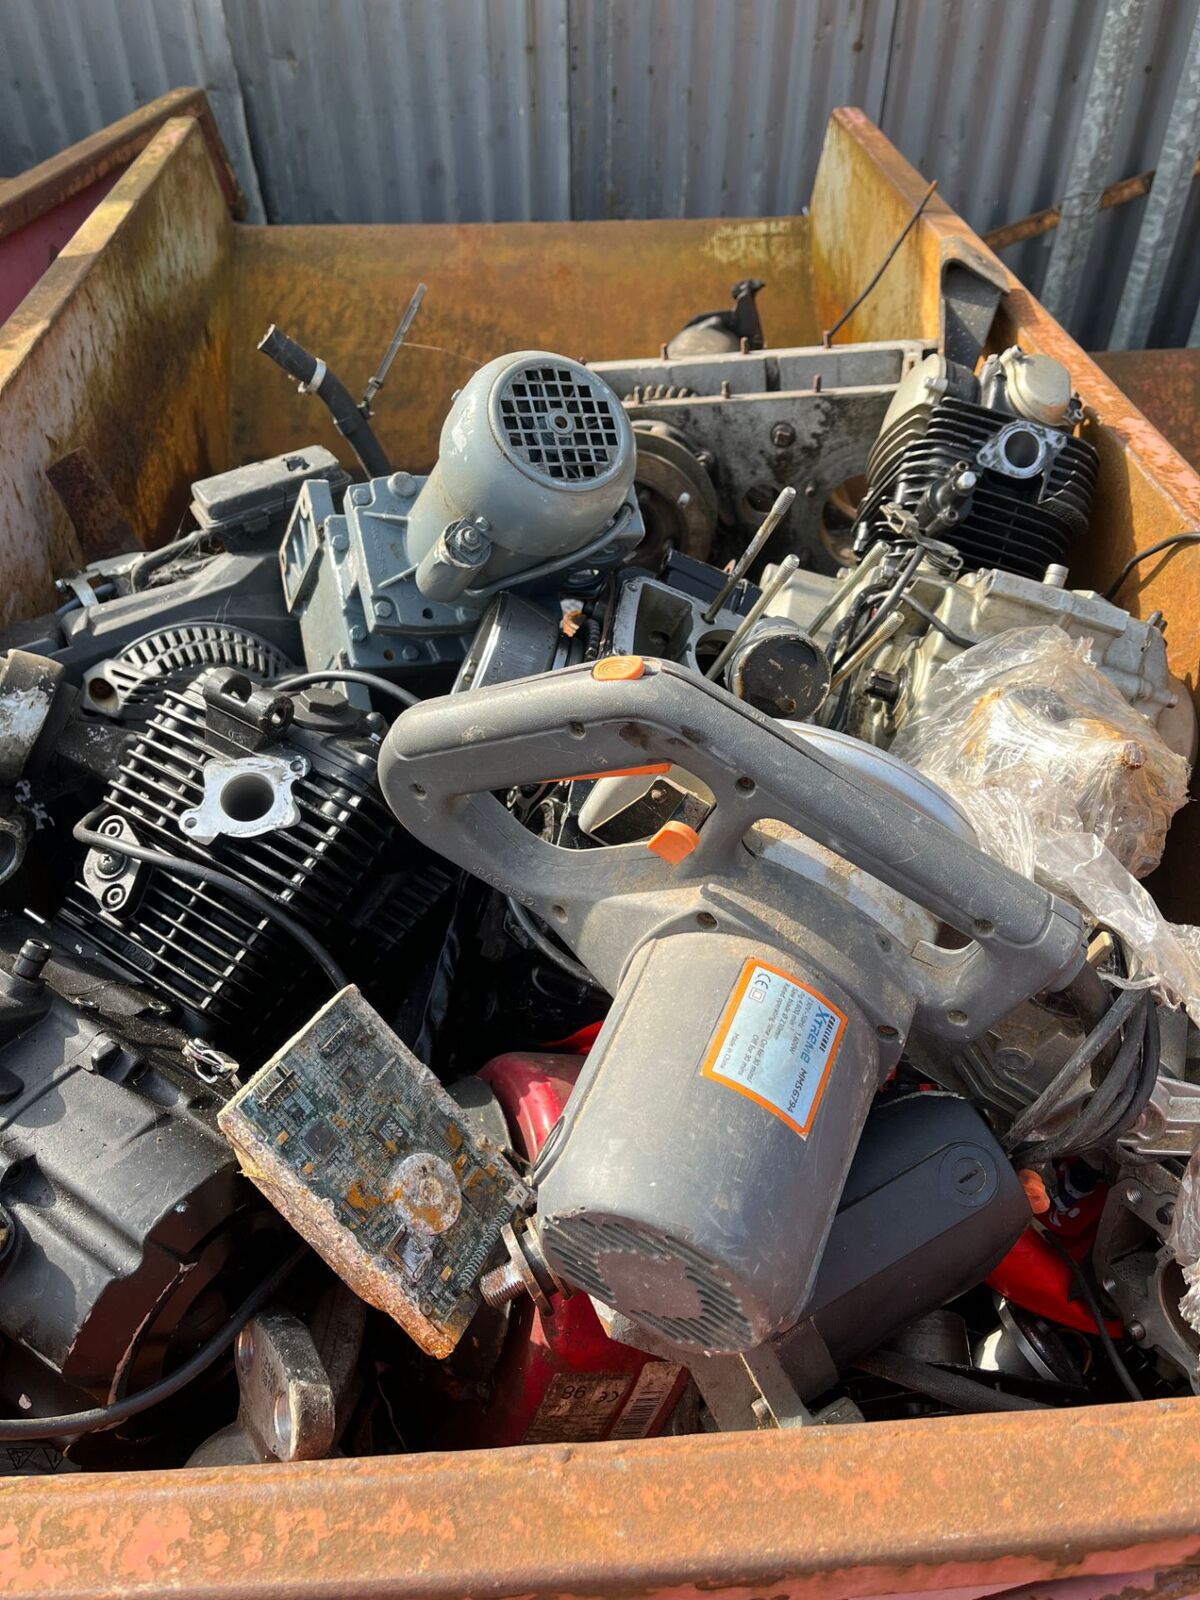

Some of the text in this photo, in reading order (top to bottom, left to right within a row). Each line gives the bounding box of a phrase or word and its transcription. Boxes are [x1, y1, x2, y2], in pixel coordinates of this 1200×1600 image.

[767, 997, 782, 1023] operating
[729, 1032, 740, 1048] Made
[819, 1015, 836, 1052] CHALLENGE
[719, 1053, 731, 1070] China
[737, 1034, 759, 1076] Off for 30 mins
[756, 1048, 764, 1057] for
[786, 1067, 808, 1113] MMS6794
